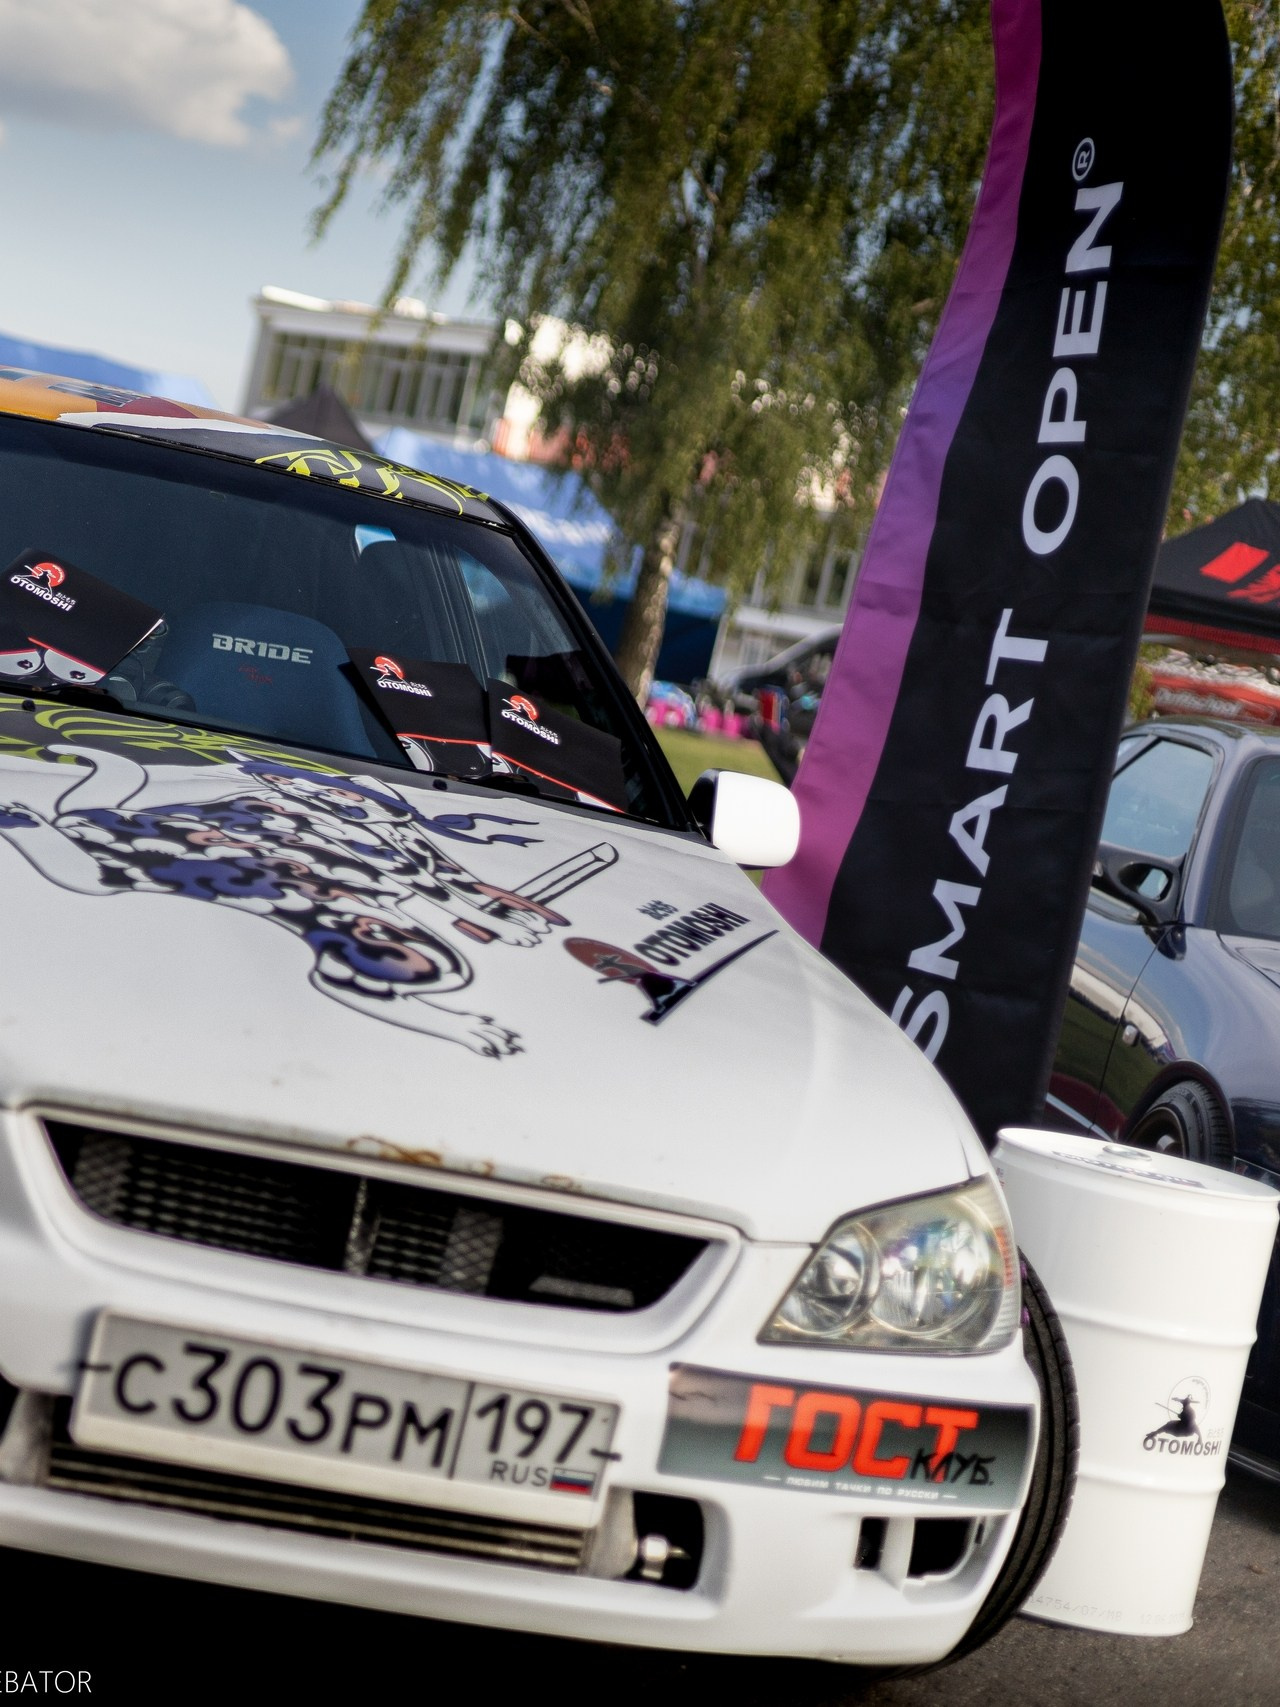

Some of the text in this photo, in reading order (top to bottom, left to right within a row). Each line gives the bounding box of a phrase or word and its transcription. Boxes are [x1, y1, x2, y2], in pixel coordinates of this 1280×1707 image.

[10, 576, 73, 612] OTOMOSHI
[212, 633, 314, 665] BRIDE
[377, 680, 433, 697] OTOMOSHI
[501, 710, 559, 745] OTOMOSHI
[891, 608, 1050, 1062] SMART
[633, 902, 752, 966] OTOMOSHI
[475, 1393, 596, 1465] 197
[733, 1382, 980, 1484] ГОСТ
[1142, 1436, 1222, 1456] OTOMOSHI
[489, 1460, 549, 1488] RUS
[834, 1481, 872, 1493] ТАЧКИ
